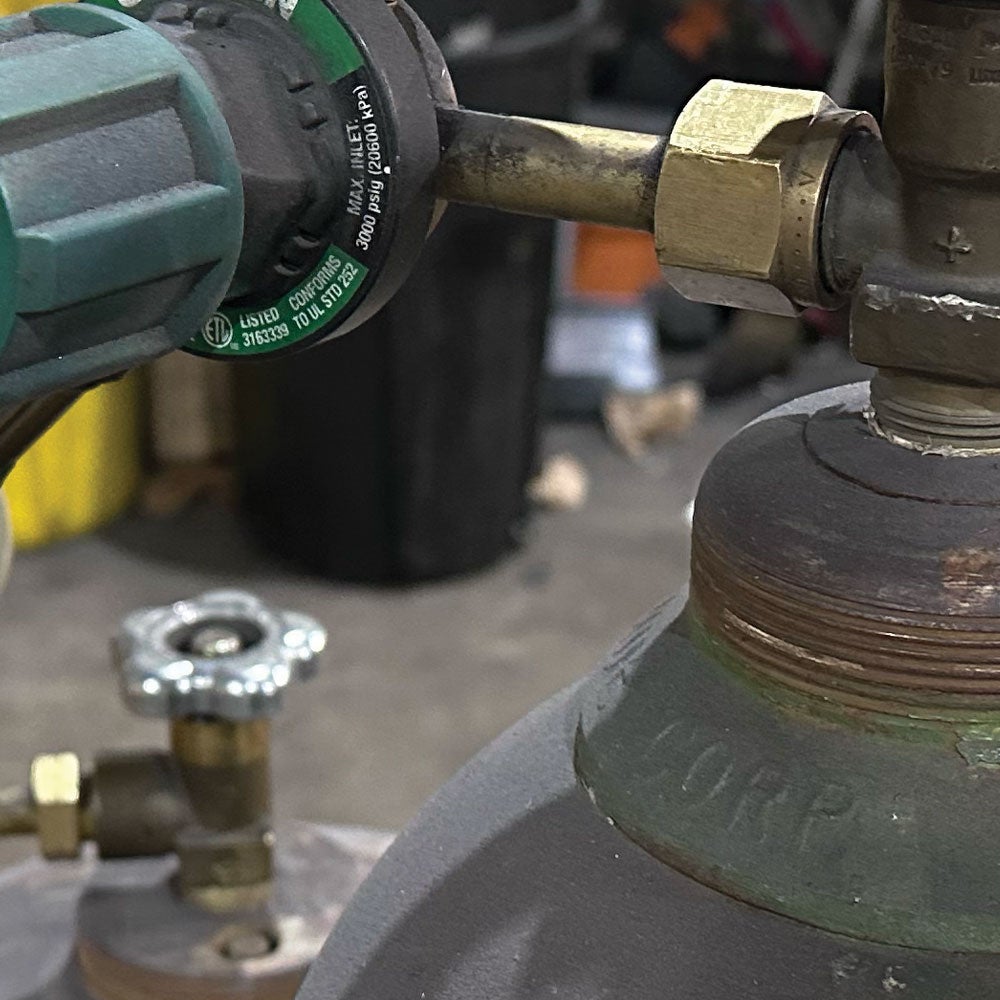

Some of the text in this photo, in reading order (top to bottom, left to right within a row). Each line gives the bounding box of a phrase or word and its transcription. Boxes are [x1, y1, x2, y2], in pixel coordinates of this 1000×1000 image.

[352, 85, 385, 251] 3000 psig (20600 kPa)
[288, 254, 341, 311] CONFORMS
[292, 262, 359, 330] TO UL STD 252
[239, 306, 280, 329] LISTED
[242, 323, 289, 347] 3163339
